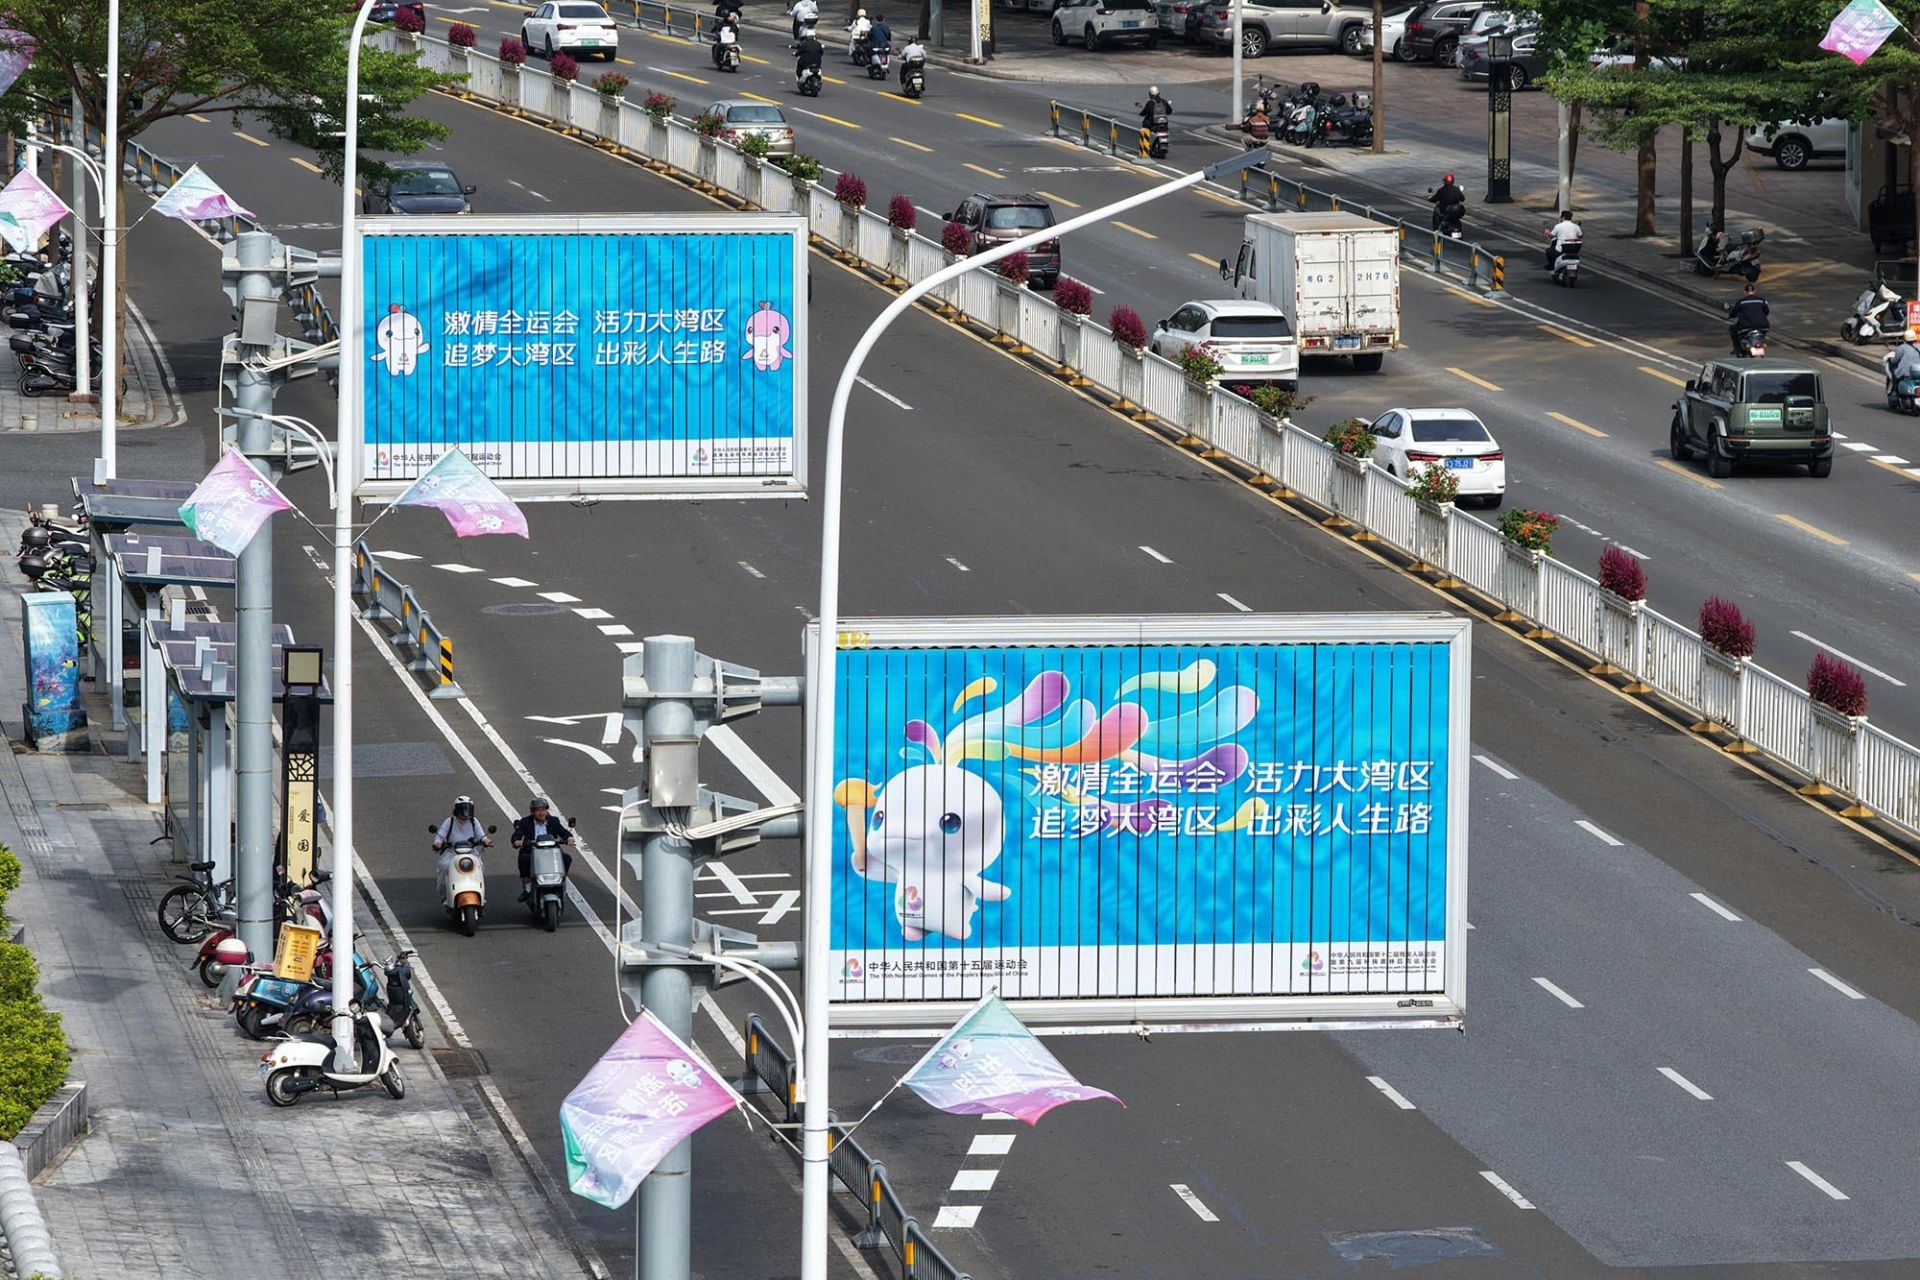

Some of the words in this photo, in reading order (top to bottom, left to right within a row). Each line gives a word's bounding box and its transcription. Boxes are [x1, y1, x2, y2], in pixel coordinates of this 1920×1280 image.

[442, 309, 580, 335] 激情全运会
[592, 308, 727, 335] 活力大湾区
[442, 341, 578, 367] 追梦大湾区
[595, 340, 727, 366] 出彩人生路
[1029, 760, 1226, 798] 激情全运会
[1243, 758, 1434, 795] 活力大湾区
[1029, 804, 1222, 840] 追梦大湾区
[1245, 801, 1434, 837] 出彩人生路
[868, 959, 1029, 972] 中华人民共和国第十五届运动会
